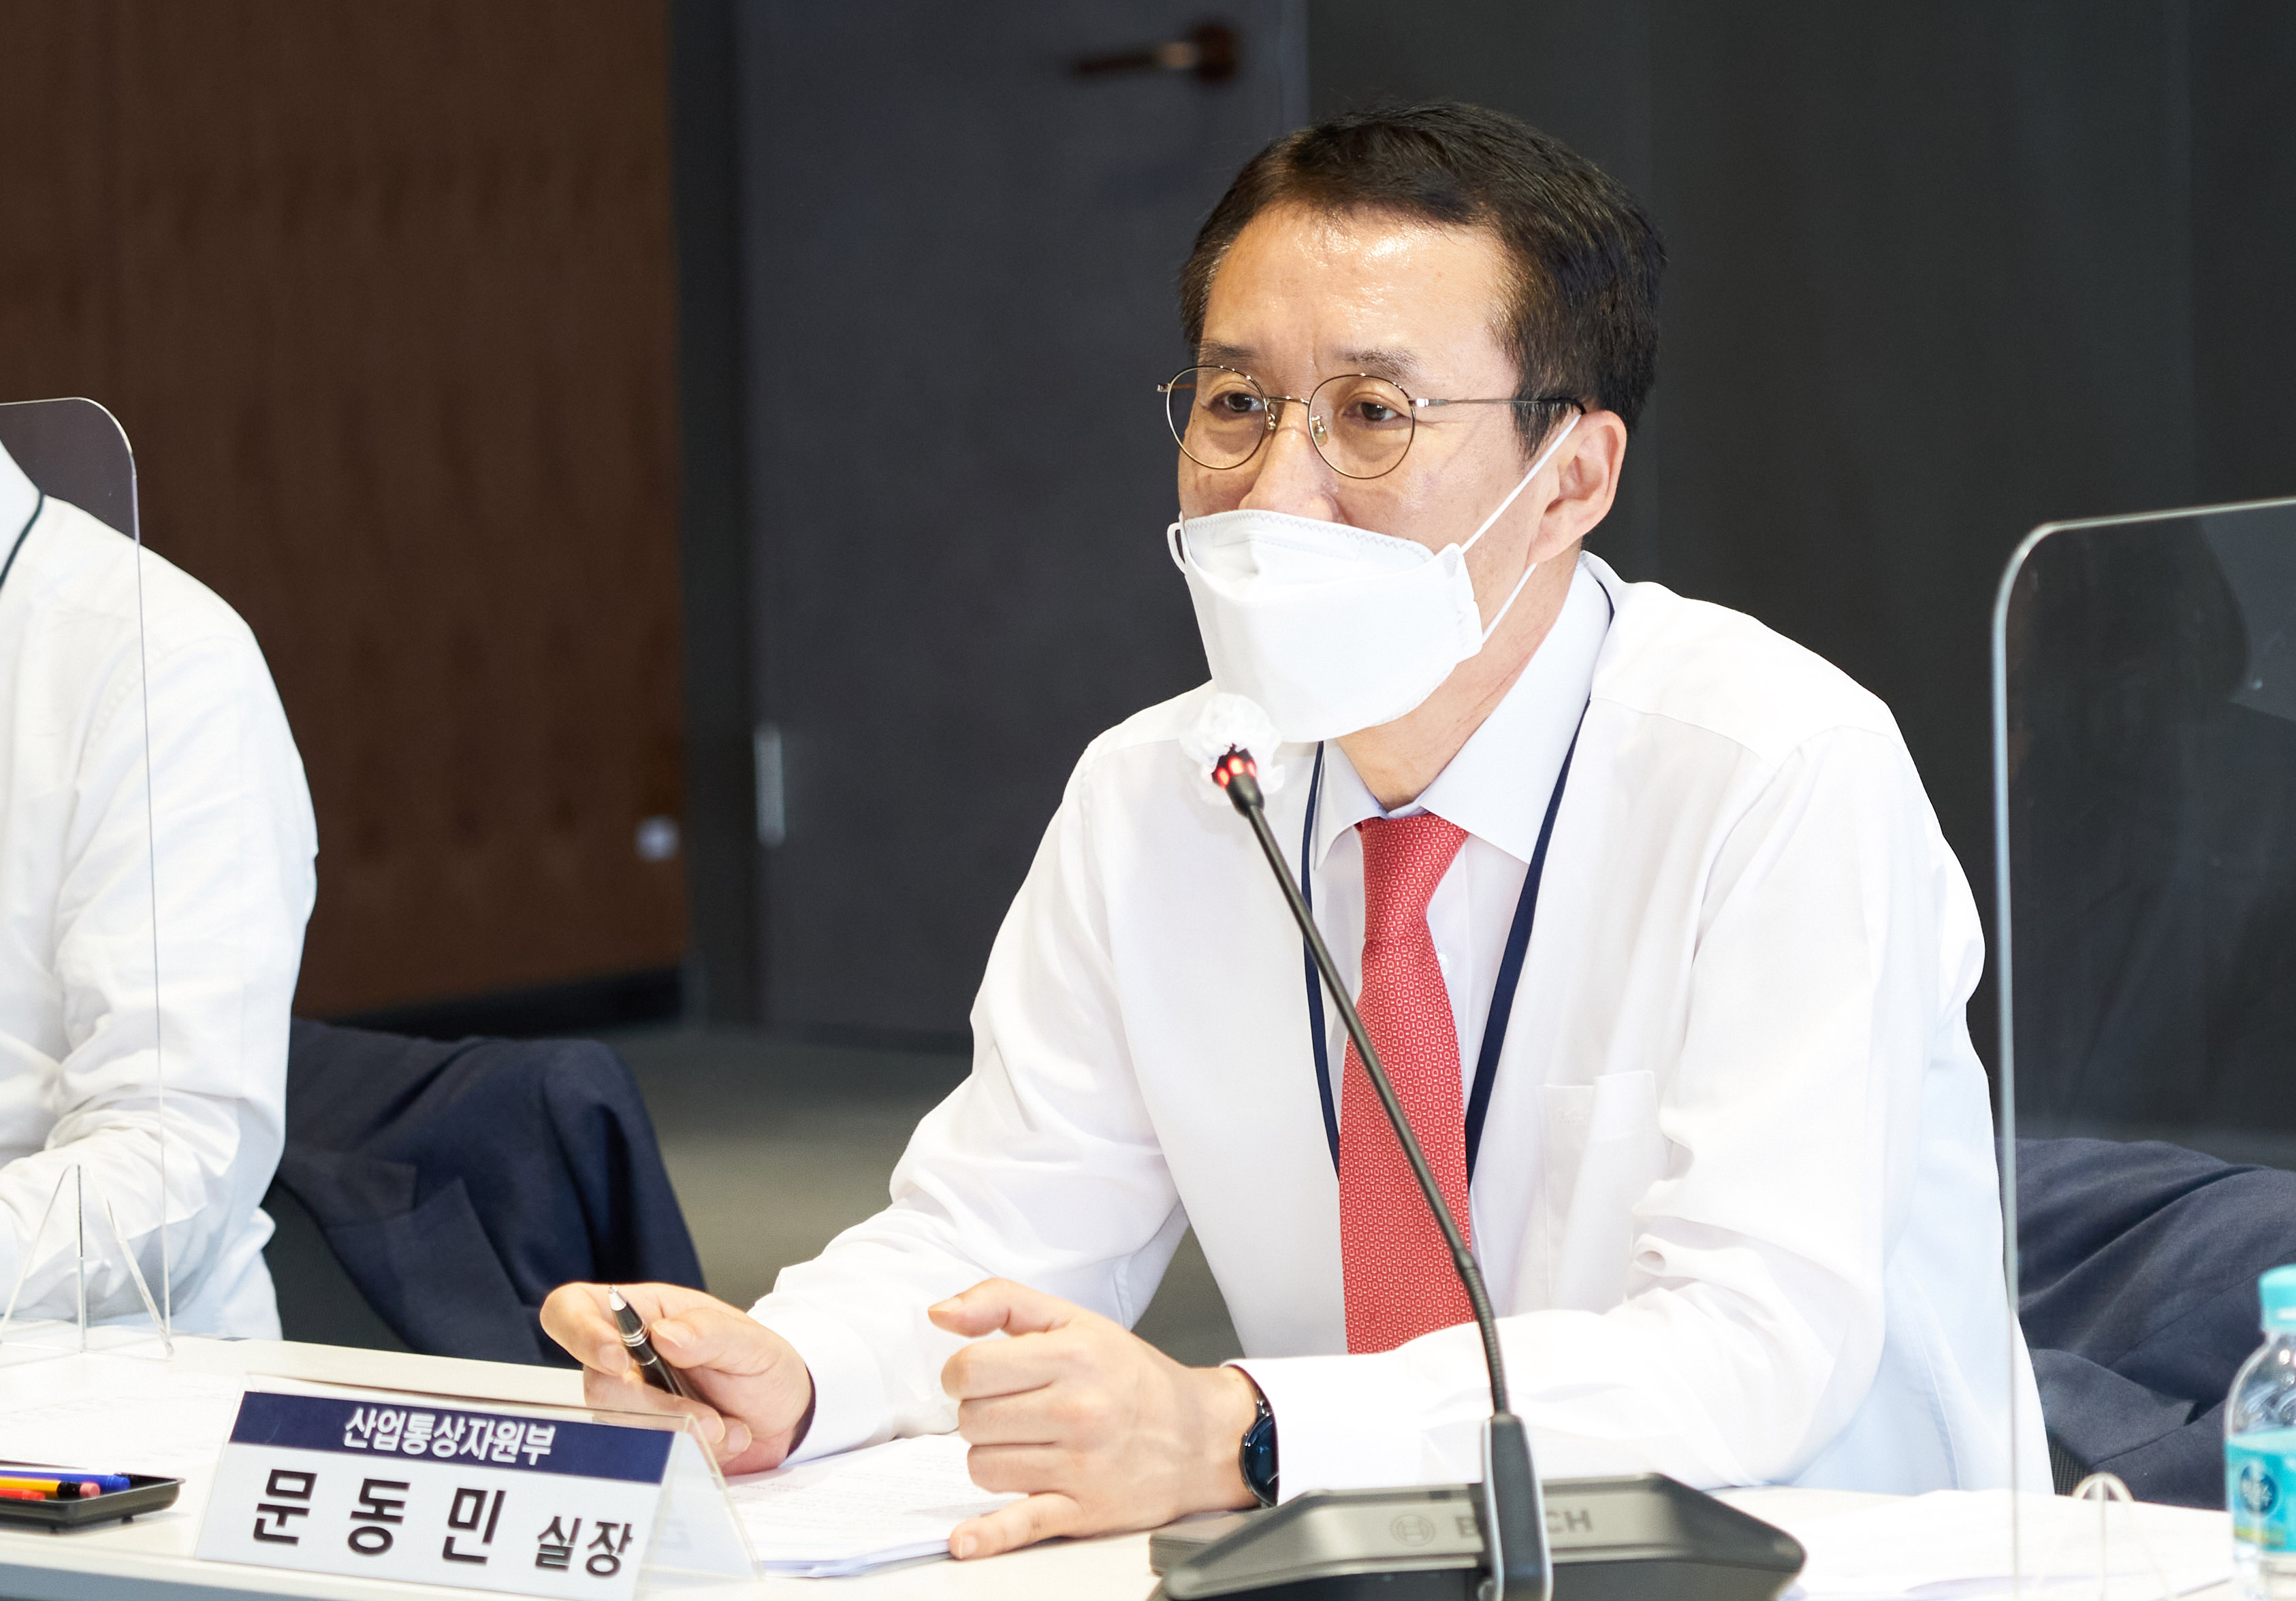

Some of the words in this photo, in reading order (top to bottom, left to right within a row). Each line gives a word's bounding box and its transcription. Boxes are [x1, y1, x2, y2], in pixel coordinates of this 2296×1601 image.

[343, 1406, 556, 1466] 산업통상자원부
[535, 1515, 633, 1577] 실장
[1454, 1509, 1593, 1538] BCH
